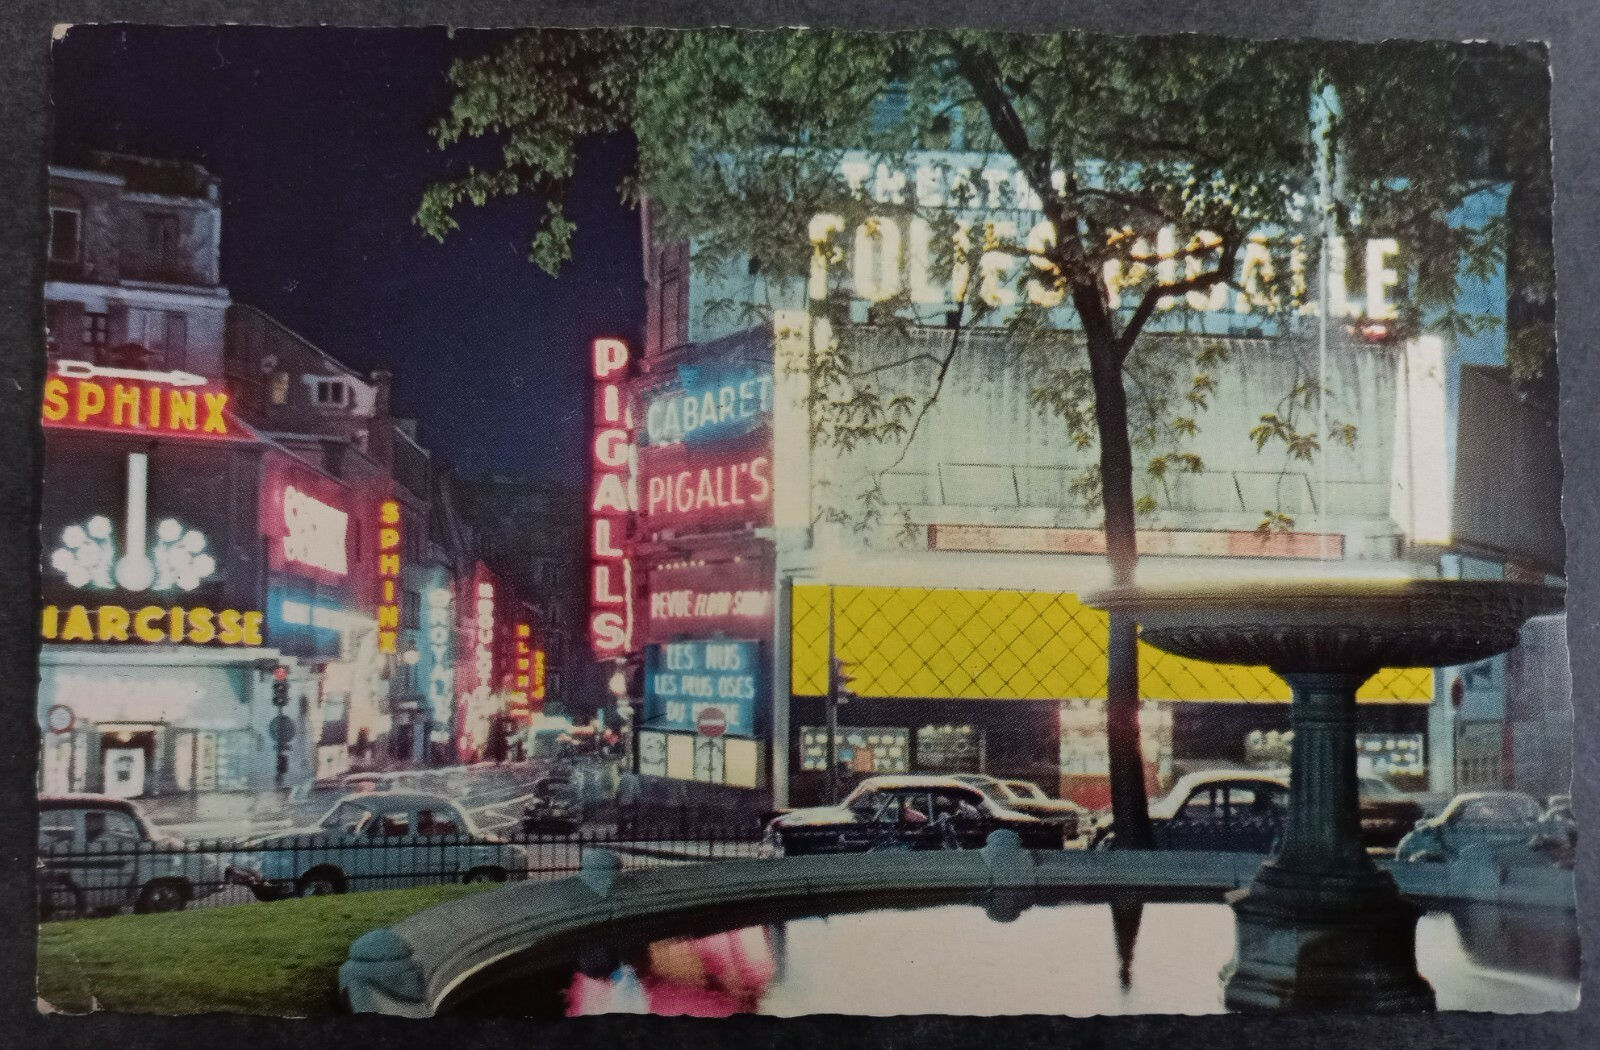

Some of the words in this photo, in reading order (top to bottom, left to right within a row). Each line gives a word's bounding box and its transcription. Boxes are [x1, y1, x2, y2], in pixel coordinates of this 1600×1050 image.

[808, 213, 1067, 308] FOLIES
[42, 379, 228, 434] SPHINX
[647, 374, 773, 444] CABARET
[592, 338, 629, 650] PIGALLS
[649, 457, 769, 516] PIGALL'S
[379, 501, 400, 653] SPHINX
[651, 590, 693, 618] REVUE
[654, 675, 677, 695] LES
[667, 643, 694, 670] LES
